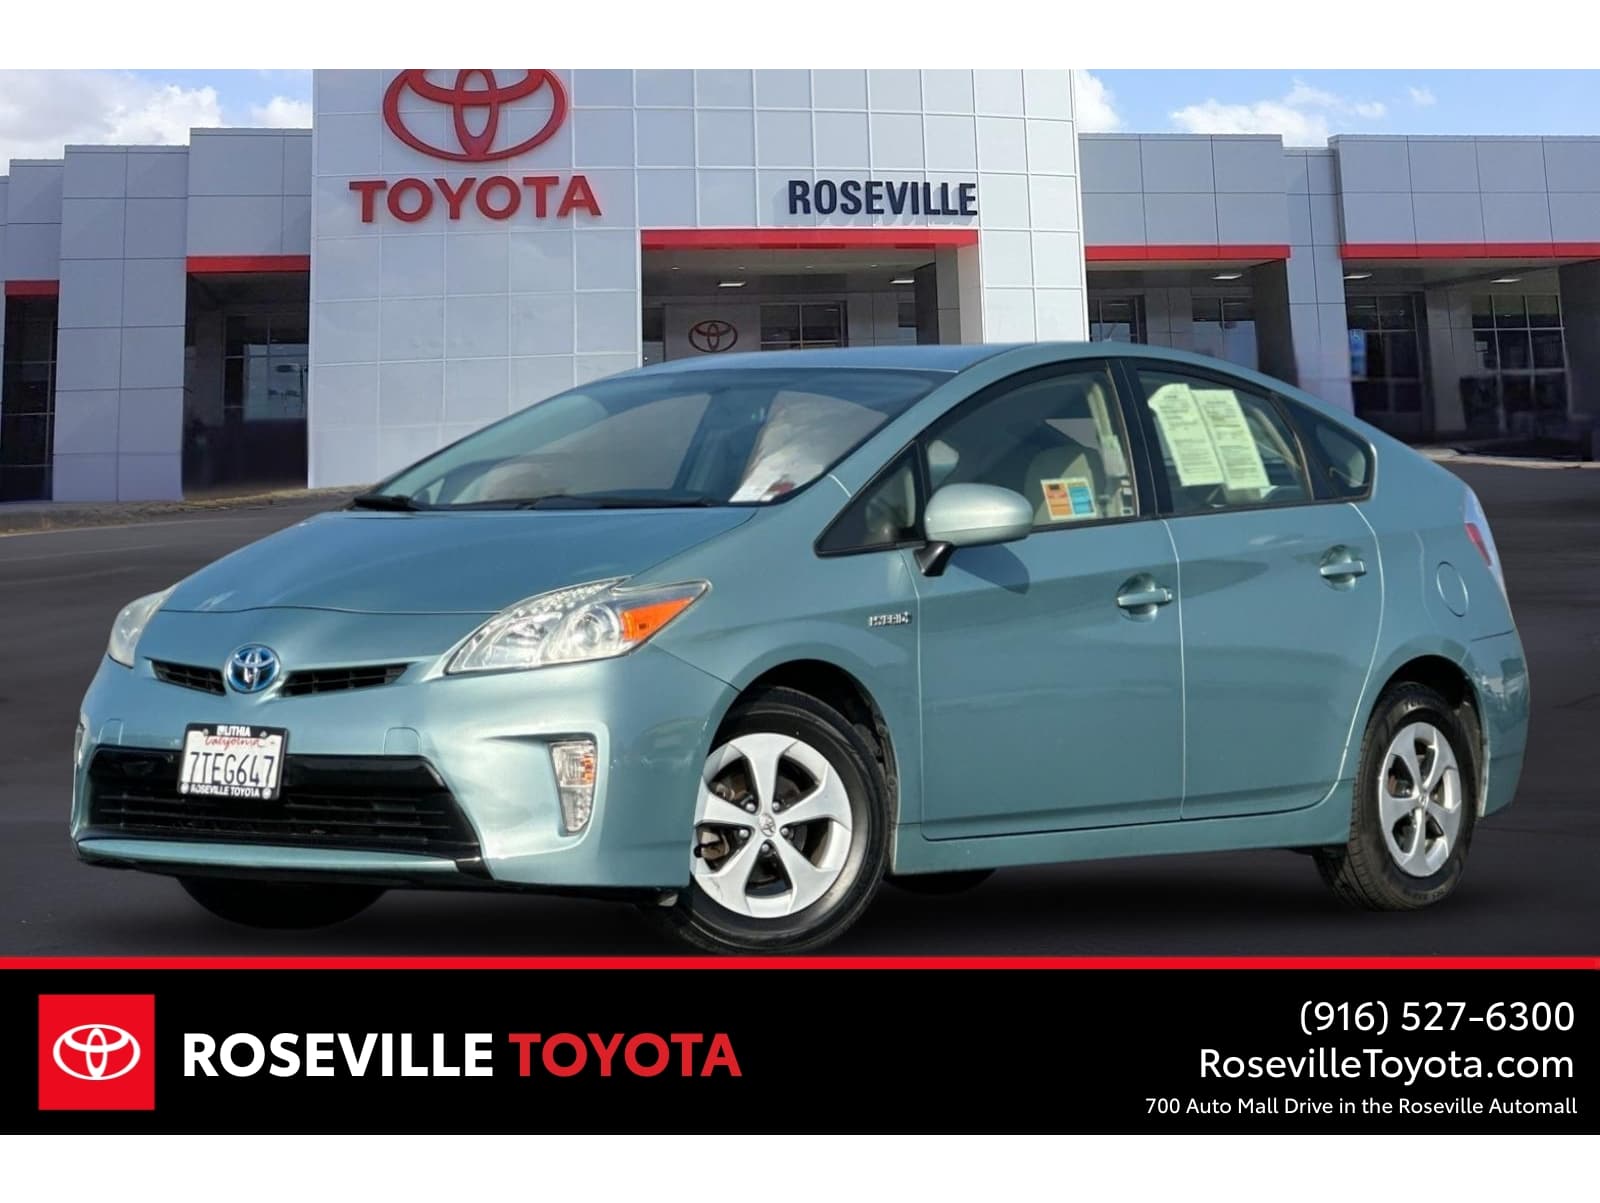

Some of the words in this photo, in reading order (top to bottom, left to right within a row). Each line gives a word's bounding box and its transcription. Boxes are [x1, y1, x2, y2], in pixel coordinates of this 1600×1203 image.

[349, 175, 602, 222] TOYOTA
[788, 179, 978, 217] ROSEVILLE
[190, 751, 275, 788] 7TEG647
[190, 783, 229, 796] ROSEVILLE
[230, 786, 261, 798] TOYOTA
